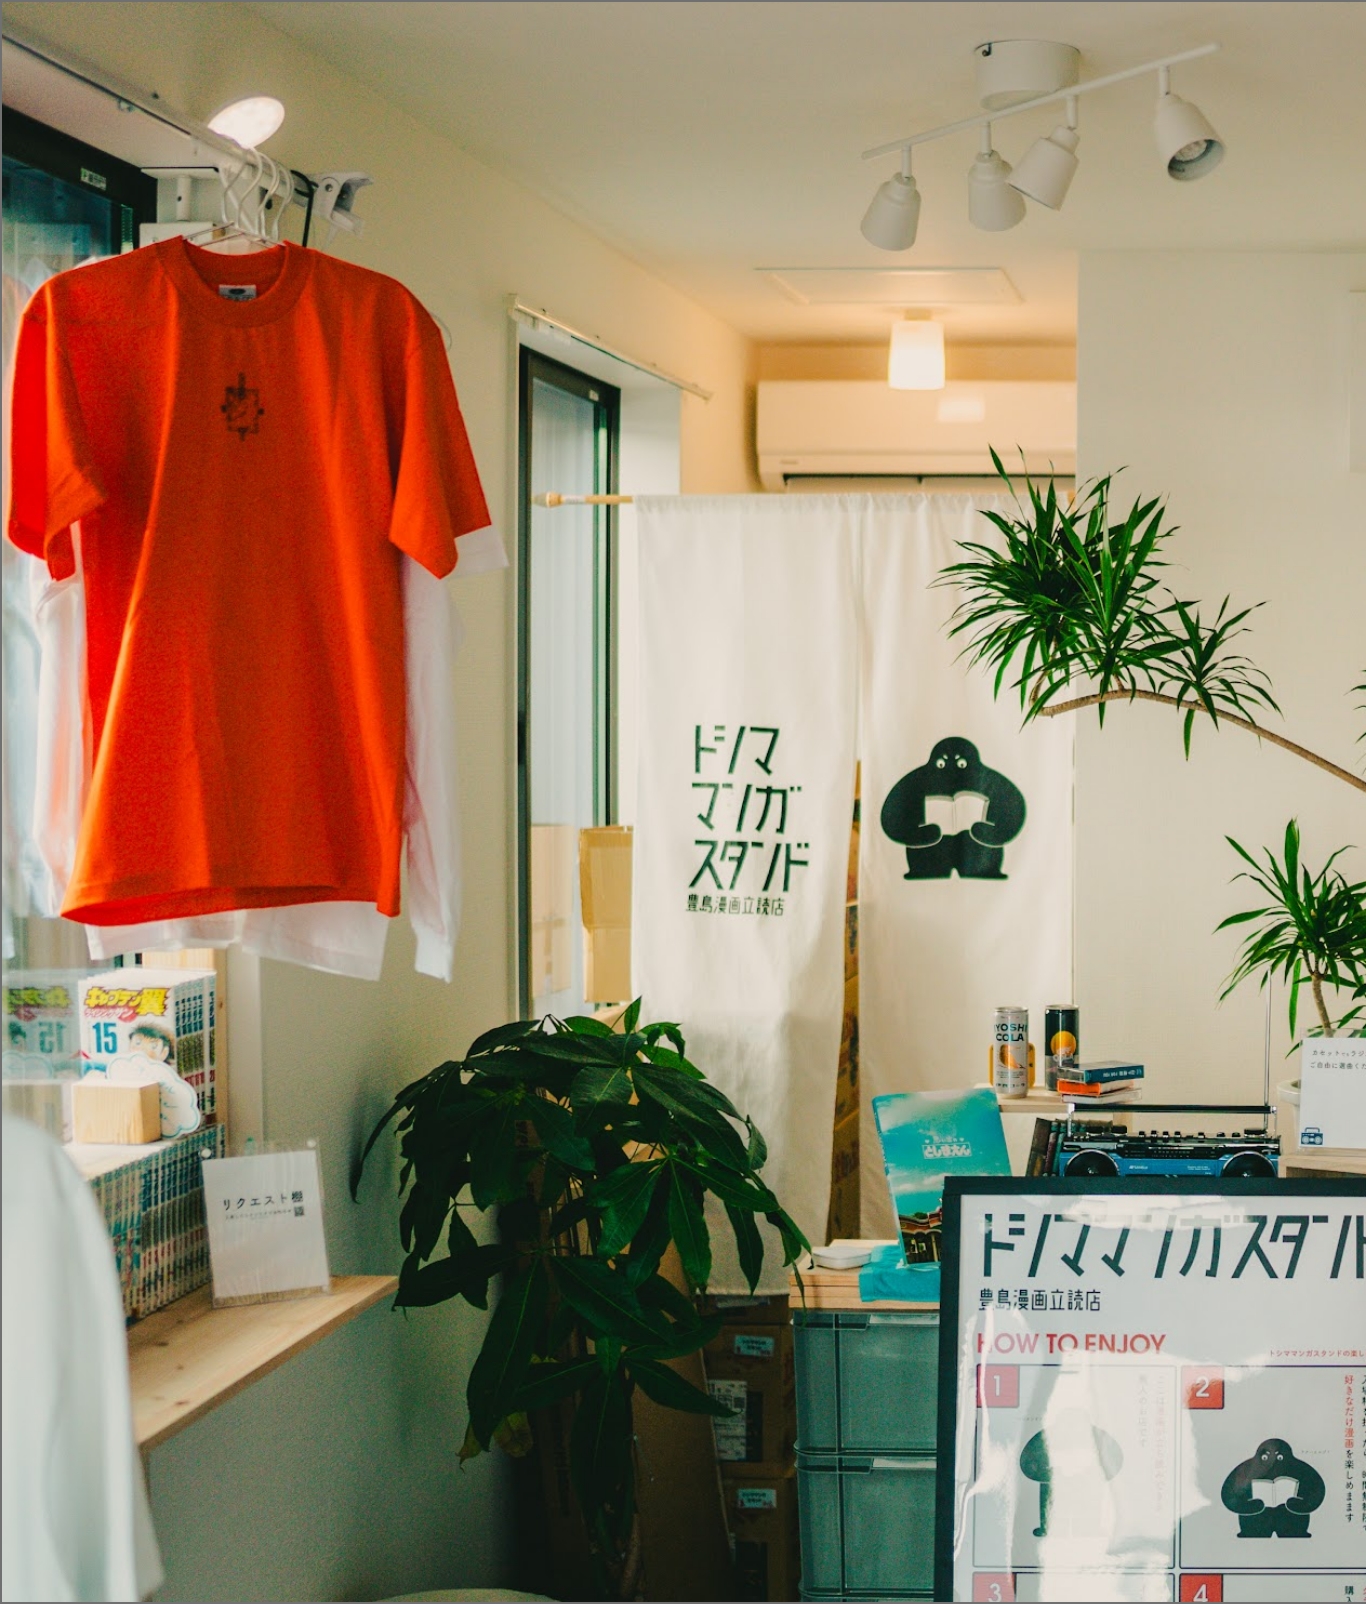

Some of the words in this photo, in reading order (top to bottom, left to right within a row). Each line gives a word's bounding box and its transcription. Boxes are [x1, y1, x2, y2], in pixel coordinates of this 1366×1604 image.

[692, 783, 802, 834] マンガ
[688, 840, 809, 892] スタンド
[685, 894, 785, 916] 豊島漫画立読店
[92, 1022, 118, 1054] 15
[996, 1033, 1024, 1041] COLA
[978, 1288, 1101, 1311] 豊島漫画立読店
[977, 1333, 1039, 1354] HOW
[1046, 1333, 1079, 1354] TO
[1085, 1333, 1167, 1355] ENJOY
[992, 1374, 1001, 1397] 1
[1195, 1375, 1210, 1398] 2
[988, 1582, 1002, 1602] 3
[1193, 1583, 1208, 1602] 4
